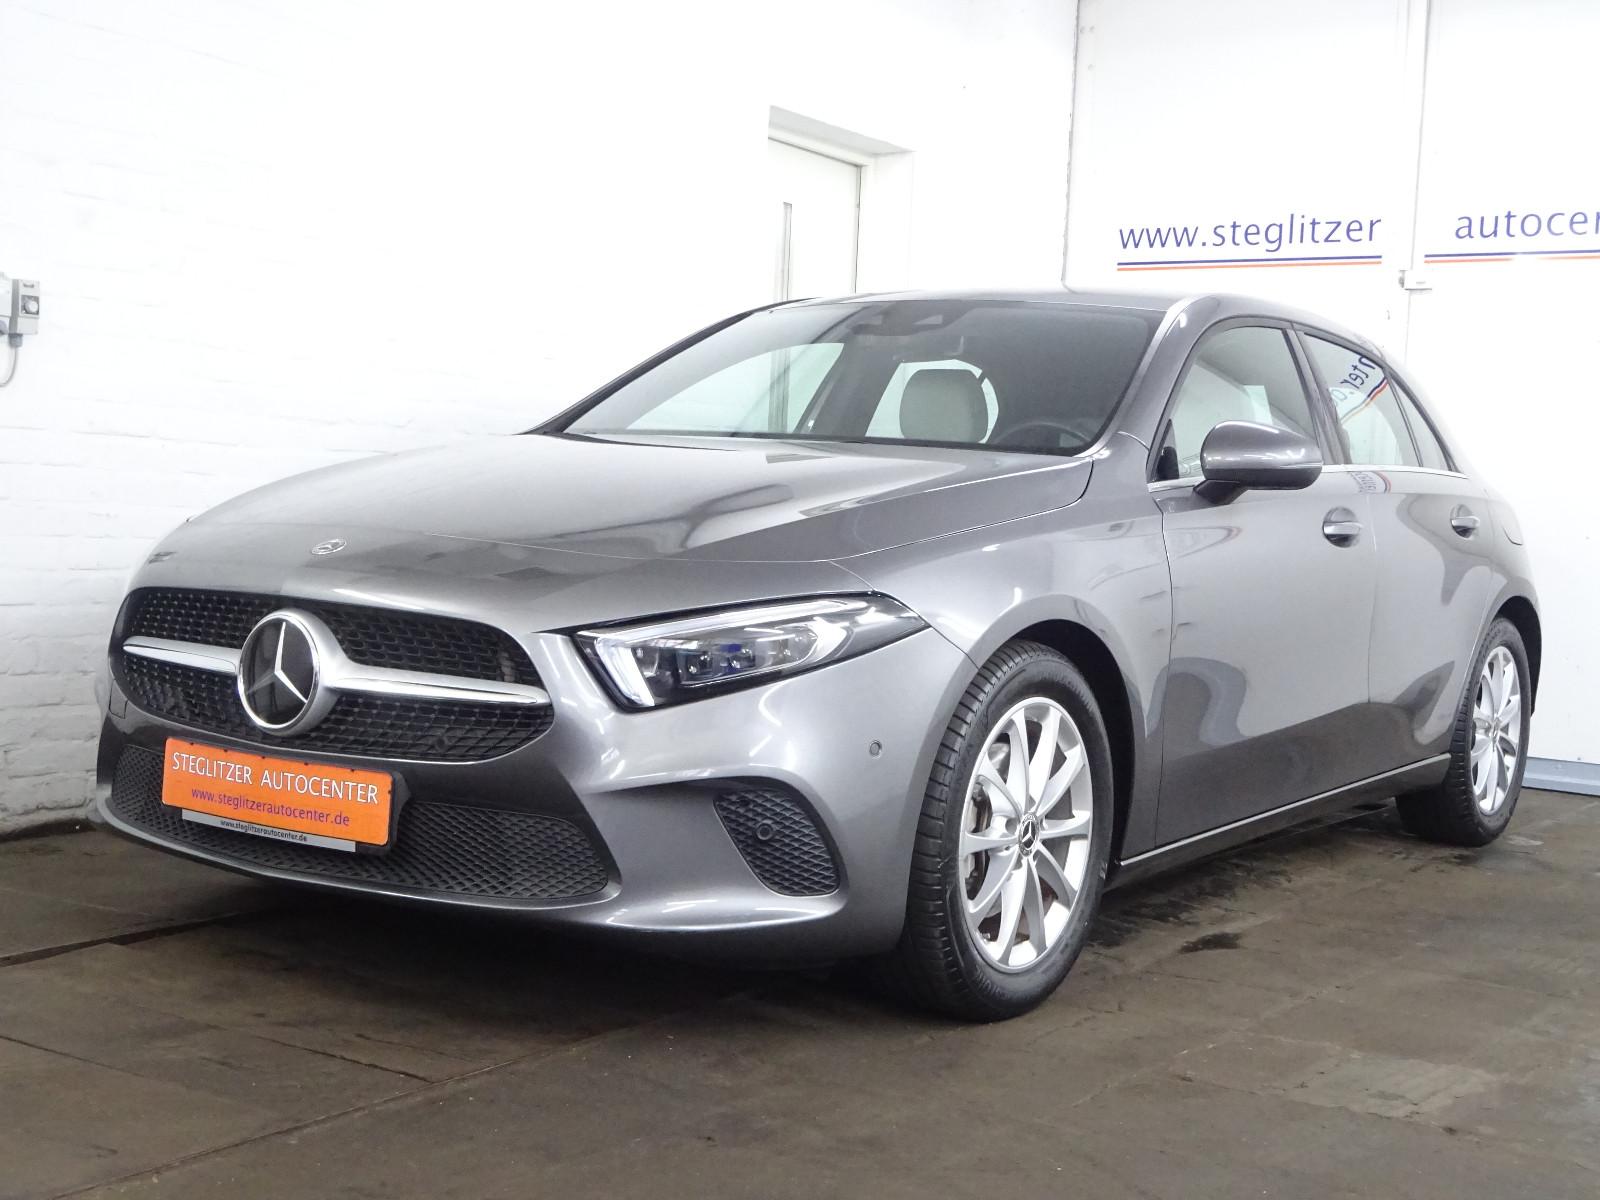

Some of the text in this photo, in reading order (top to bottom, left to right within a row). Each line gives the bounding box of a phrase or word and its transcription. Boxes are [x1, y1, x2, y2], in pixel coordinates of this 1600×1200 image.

[1119, 213, 1381, 252] www.steglitzer
[172, 752, 378, 804] STEGLITZER AUTOCENTER
[191, 788, 350, 826] www.steglitzerautocenter.de
[220, 820, 307, 842] www.steglitzerautocenter.de
